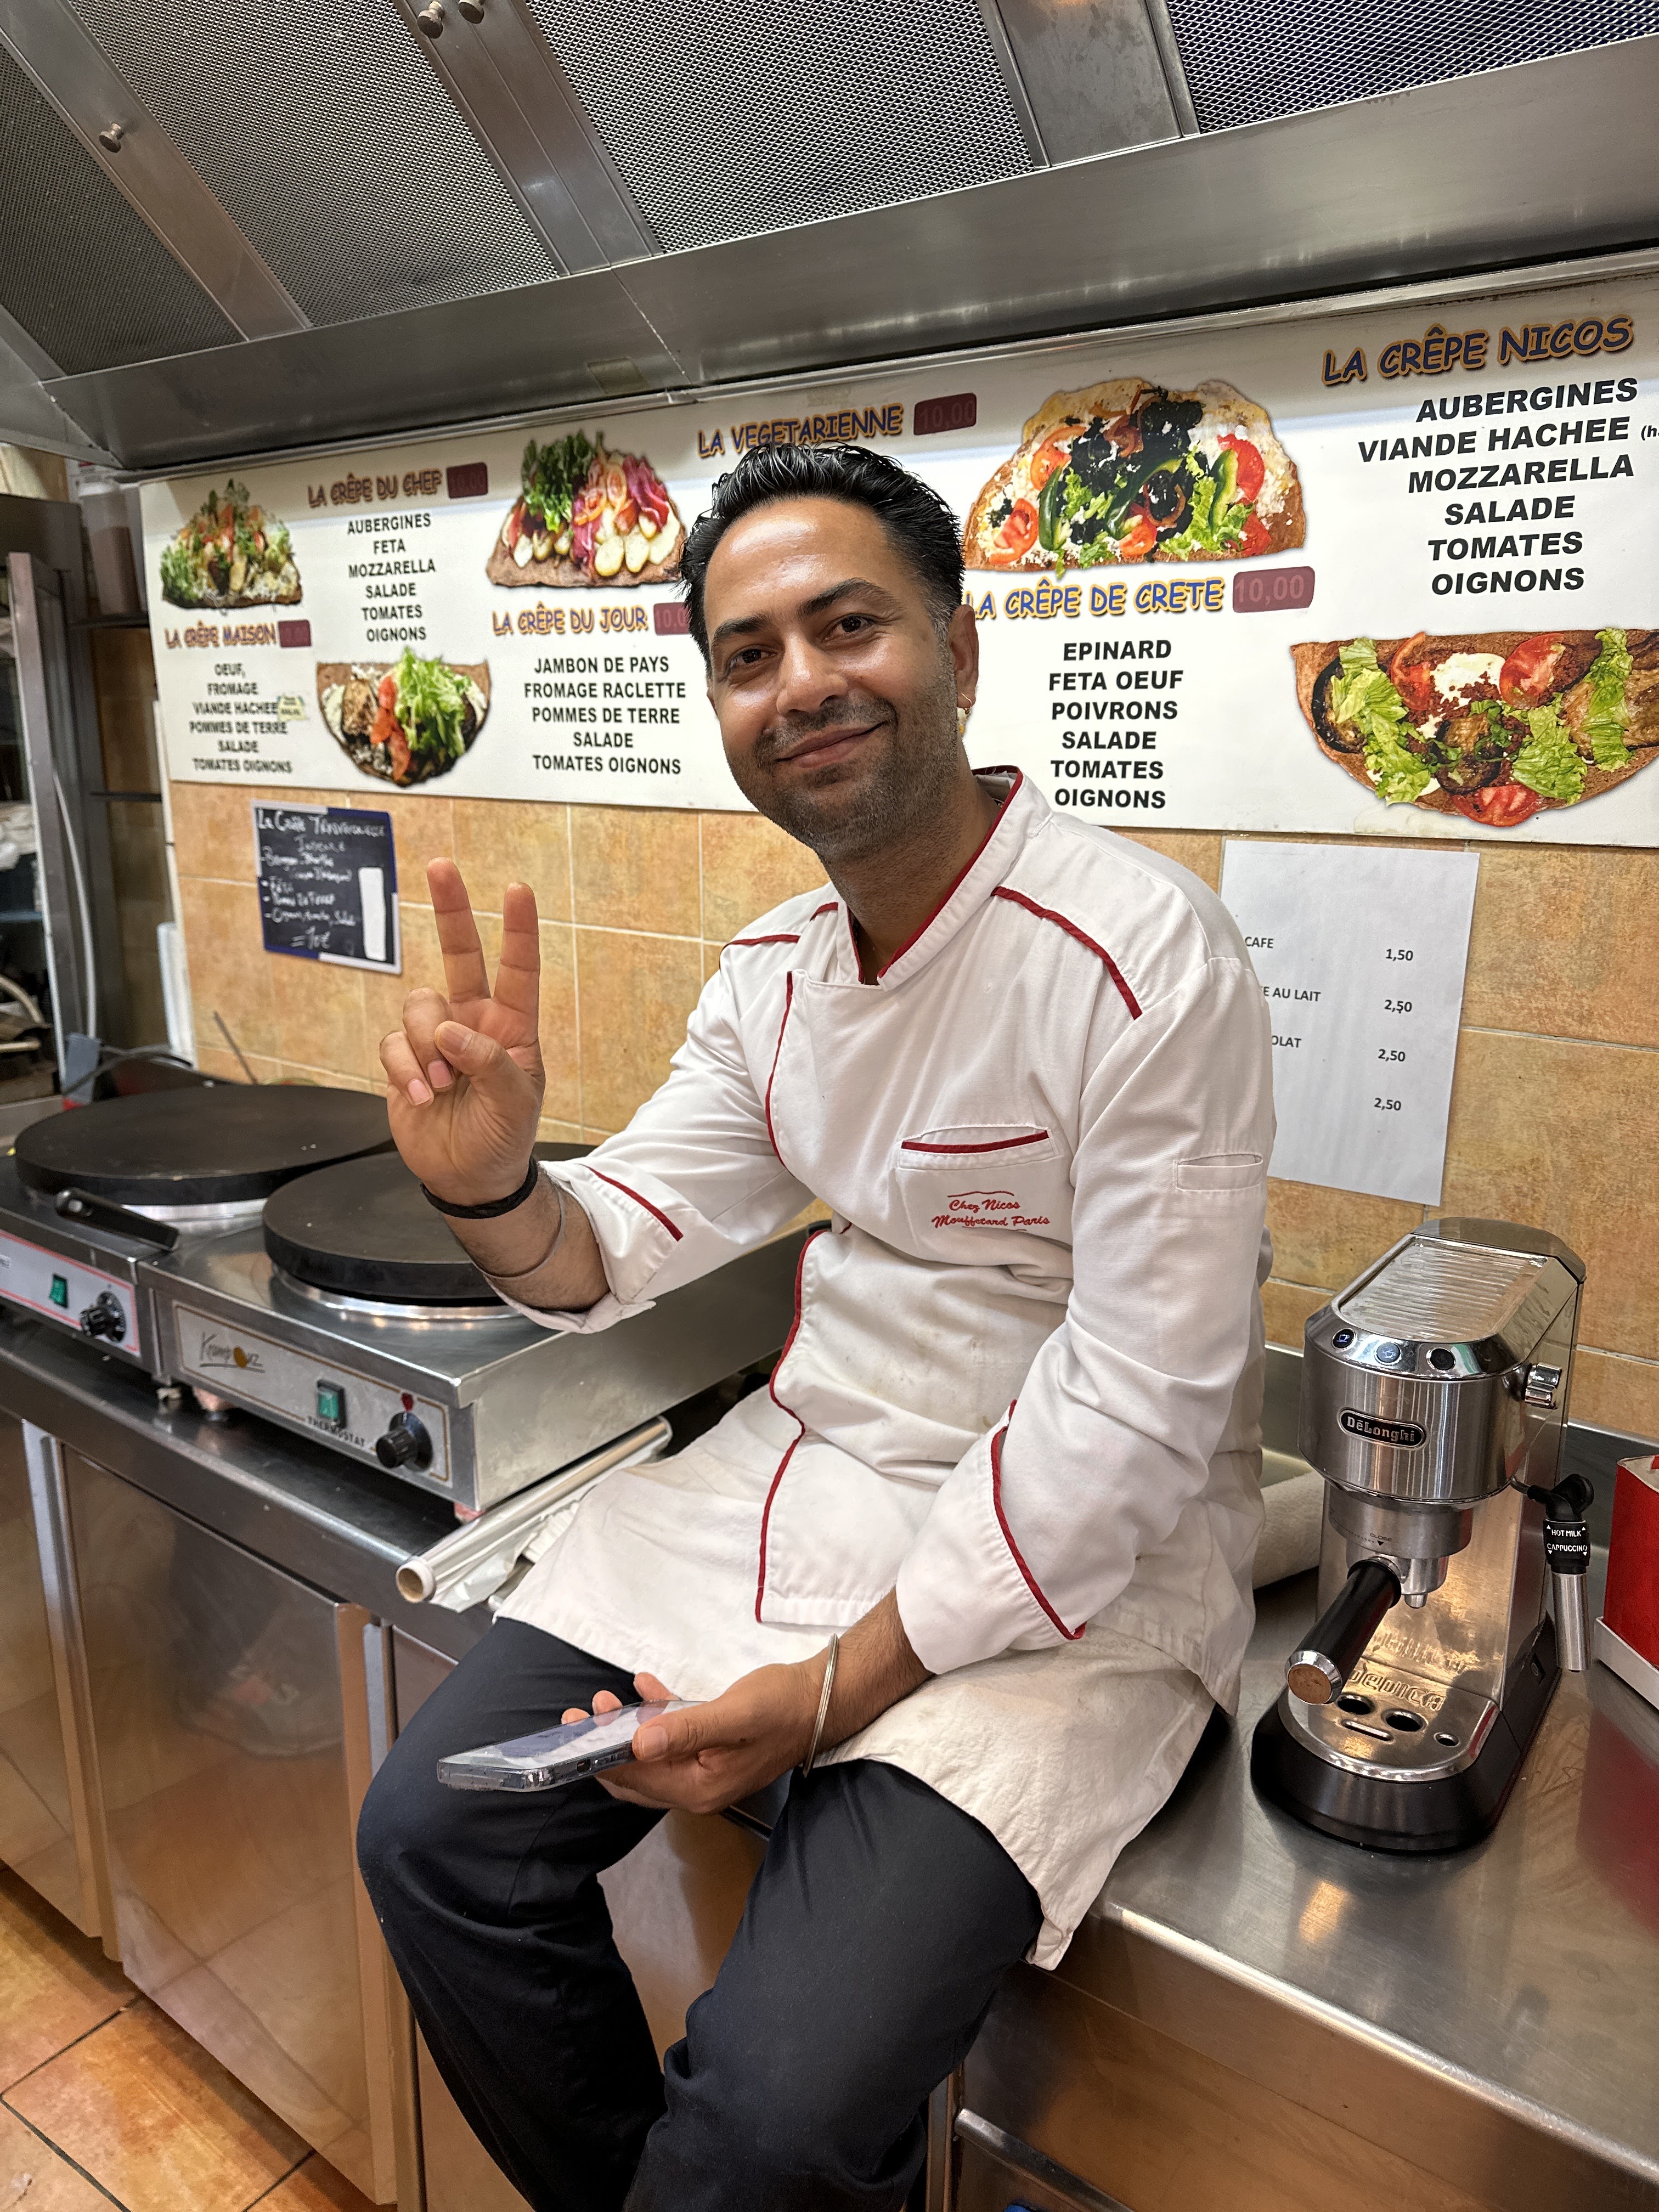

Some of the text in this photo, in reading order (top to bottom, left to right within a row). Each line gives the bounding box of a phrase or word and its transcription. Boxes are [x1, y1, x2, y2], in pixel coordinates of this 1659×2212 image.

[1322, 314, 1634, 386] LA CRÊPE NICOS
[1415, 377, 1638, 423] AUBERGINES
[697, 403, 904, 459] LA VEGETARIENNE
[1358, 431, 1476, 462] VIANDE
[1488, 416, 1630, 451] HACHEE
[1408, 454, 1634, 493] MOZZARELLA
[308, 485, 327, 509] LA
[376, 475, 398, 501] DU
[402, 467, 442, 496] CHEF
[1445, 495, 1575, 525] SALADE
[348, 513, 431, 534] AUBERGINES
[374, 539, 405, 554] FETA
[1428, 532, 1582, 561] TOMATES
[349, 559, 435, 577] MOZZARELLA
[366, 583, 416, 599] SALADE
[1233, 575, 1304, 605] 10,00
[1432, 568, 1584, 595] OIGNONS
[1005, 576, 1081, 618] CRÊPE
[1090, 582, 1129, 617] DE
[1134, 577, 1226, 614] CRETE
[362, 605, 422, 620] TOMATES
[492, 601, 648, 636] LA CRÊPE DU JOUR
[165, 627, 182, 649] LA
[222, 623, 276, 646] MAISON
[367, 627, 426, 642] OIGNONS
[1064, 640, 1171, 661] EPINARD
[535, 657, 668, 673] JAMBON DE PAYS
[207, 683, 259, 696] FROMAGE
[525, 682, 685, 698] FROMAGE RACLETTE
[1049, 670, 1183, 691] FETA OEUF
[192, 702, 231, 715] VIANDE
[533, 707, 679, 724] POMMES DE TERRE
[1052, 701, 1177, 720] POIVRONS
[189, 721, 287, 735] POMMES DE TERRE
[218, 740, 259, 753] SALADE
[574, 732, 633, 748] SALADE
[1062, 731, 1156, 749] SALADE
[192, 758, 293, 774] TOMATES OIGNONS
[533, 755, 680, 774] TOMATES OIGNONS
[1051, 760, 1163, 779] TOMATES
[1055, 789, 1165, 809] OIGNONS
[1245, 936, 1413, 961] CAFE 1,50
[1273, 988, 1290, 998] AU
[1295, 990, 1321, 1001] LAIT
[1384, 999, 1413, 1013] 2,50
[1378, 1049, 1405, 1062] 2,50
[1374, 1098, 1401, 1110] 2,50
[949, 1199, 1020, 1214] Chez Nicos
[932, 1215, 1050, 1228] Mouffetard Paris
[1547, 1543, 1588, 1552] CAPPUCCINO
